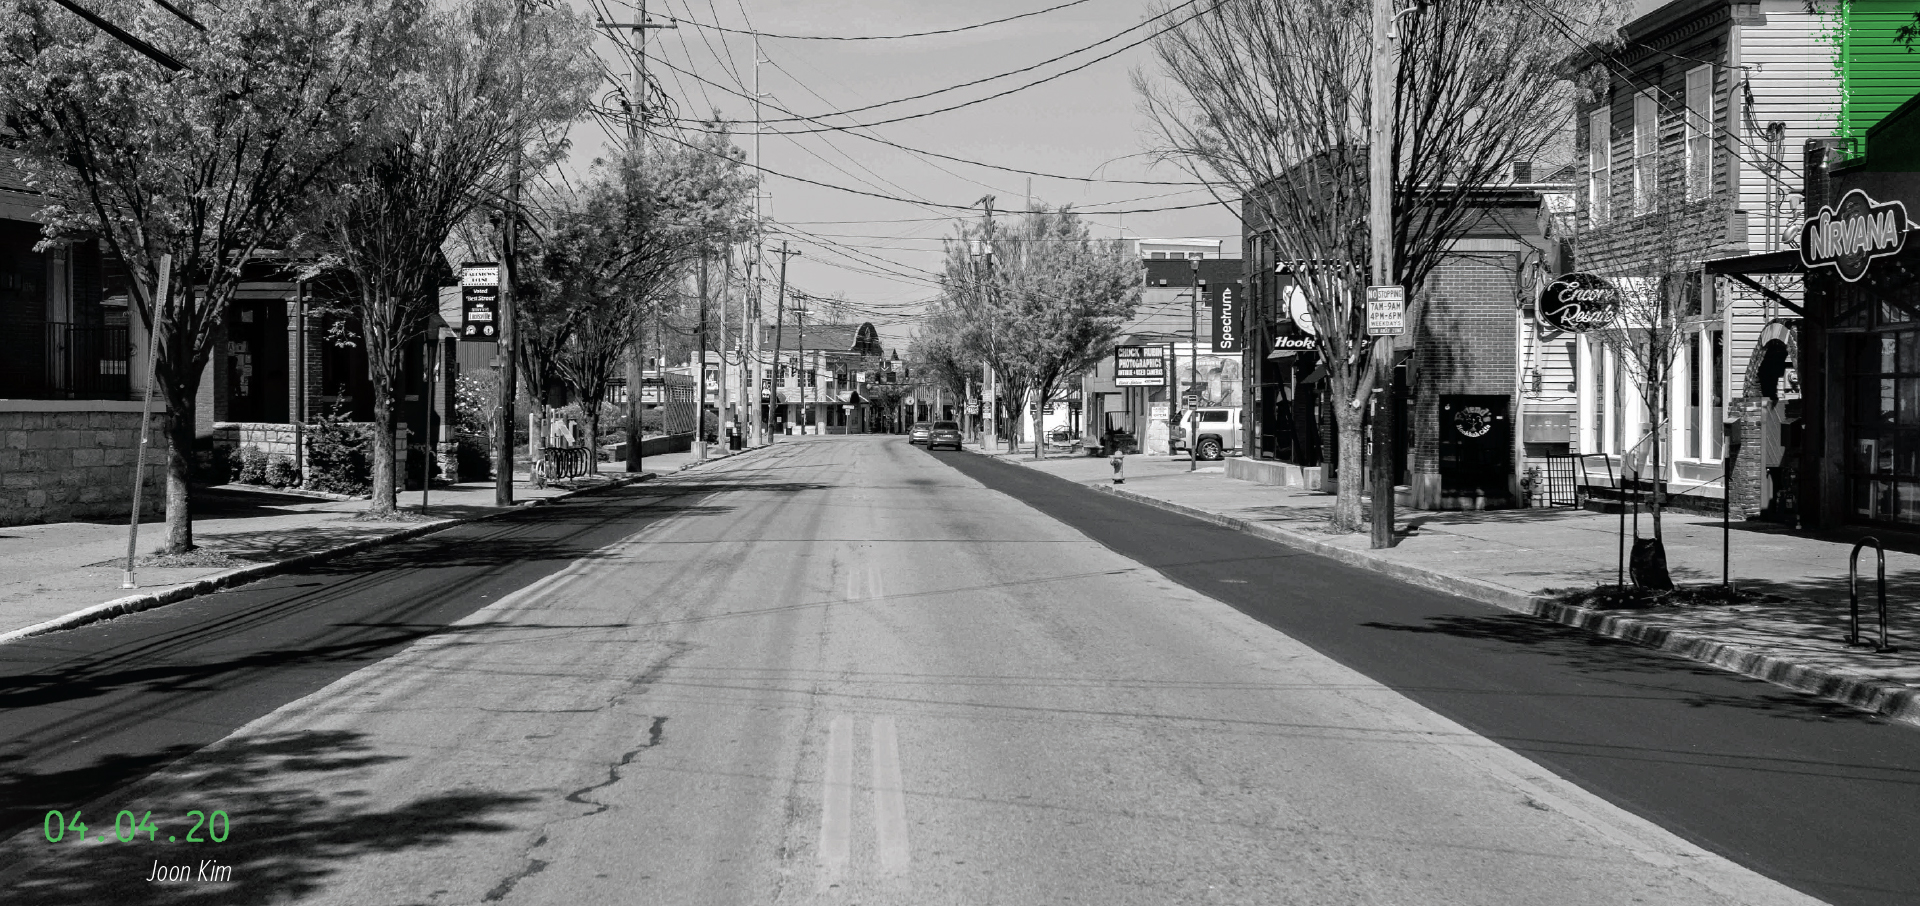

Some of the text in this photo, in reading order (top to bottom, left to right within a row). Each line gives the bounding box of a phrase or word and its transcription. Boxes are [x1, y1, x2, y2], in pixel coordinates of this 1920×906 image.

[1810, 209, 1898, 261] NIRVANA
[1368, 290, 1402, 299] NO STOPPING
[1370, 302, 1401, 311] 7AM-9AM
[1220, 291, 1235, 349] Spectrum
[1370, 311, 1402, 320] 4PM-6PM
[1118, 347, 1163, 357] CHUCK RUBIN
[1118, 358, 1162, 369] PHOTOGRAPHICS
